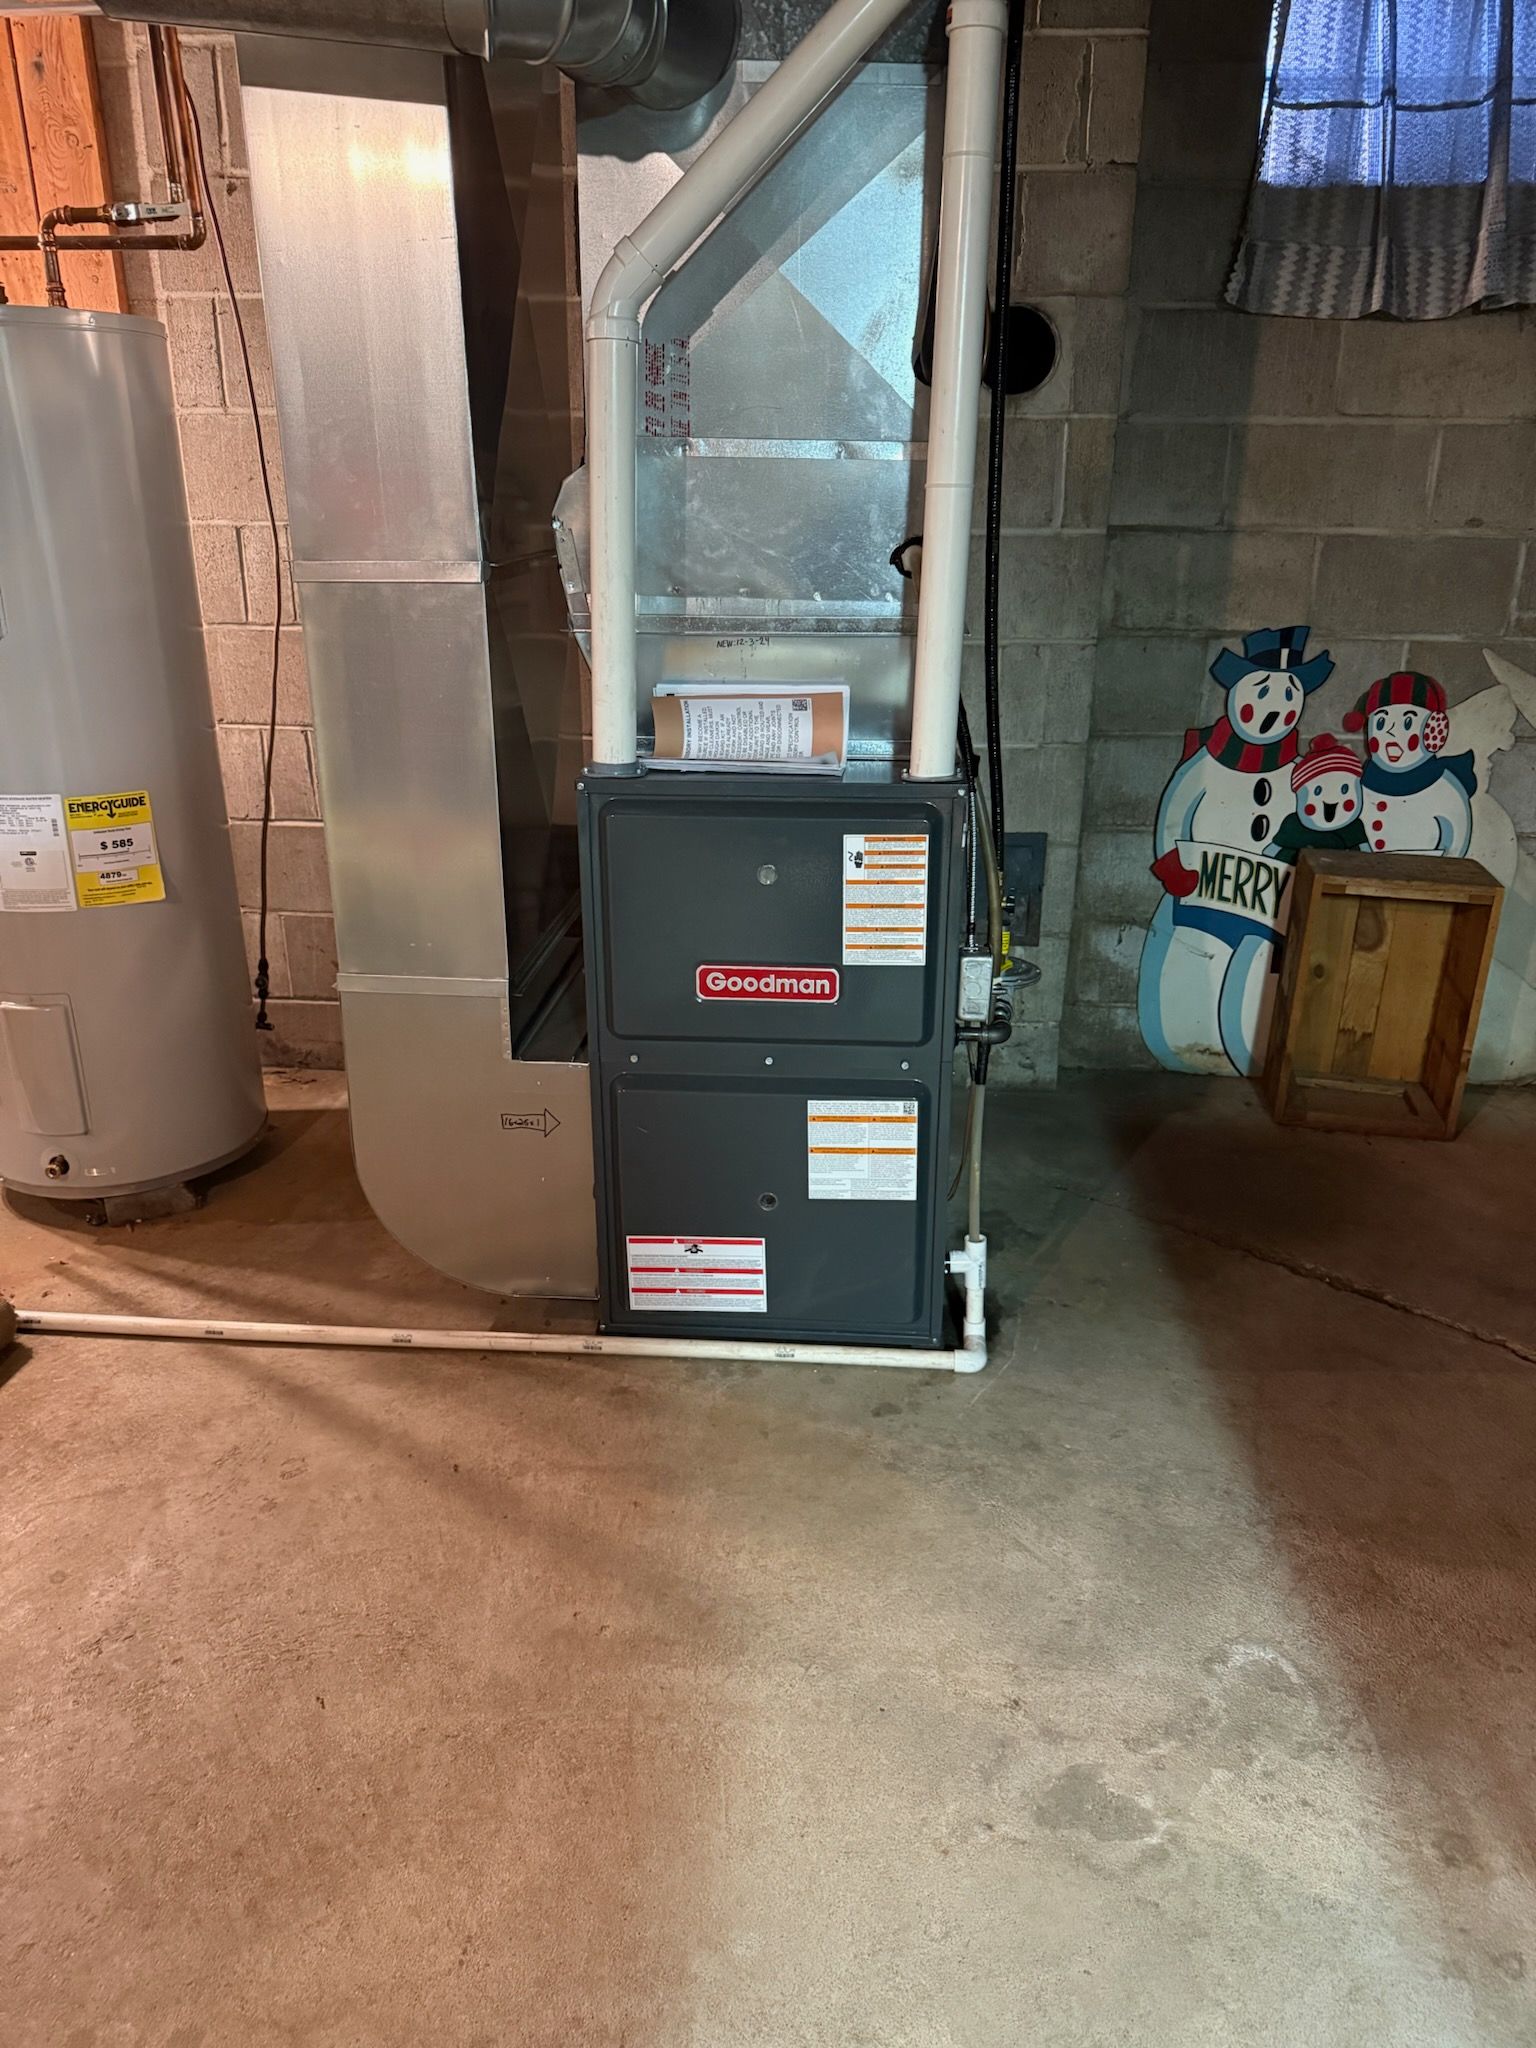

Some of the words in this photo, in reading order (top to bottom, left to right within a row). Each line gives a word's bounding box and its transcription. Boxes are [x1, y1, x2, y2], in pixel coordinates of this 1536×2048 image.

[68, 796, 146, 818] ENERGYGUIDE
[100, 841, 108, 850] $
[112, 838, 133, 849] 585
[100, 871, 122, 880] 4879
[1198, 851, 1291, 919] MERRY
[706, 972, 830, 994] Goodman
